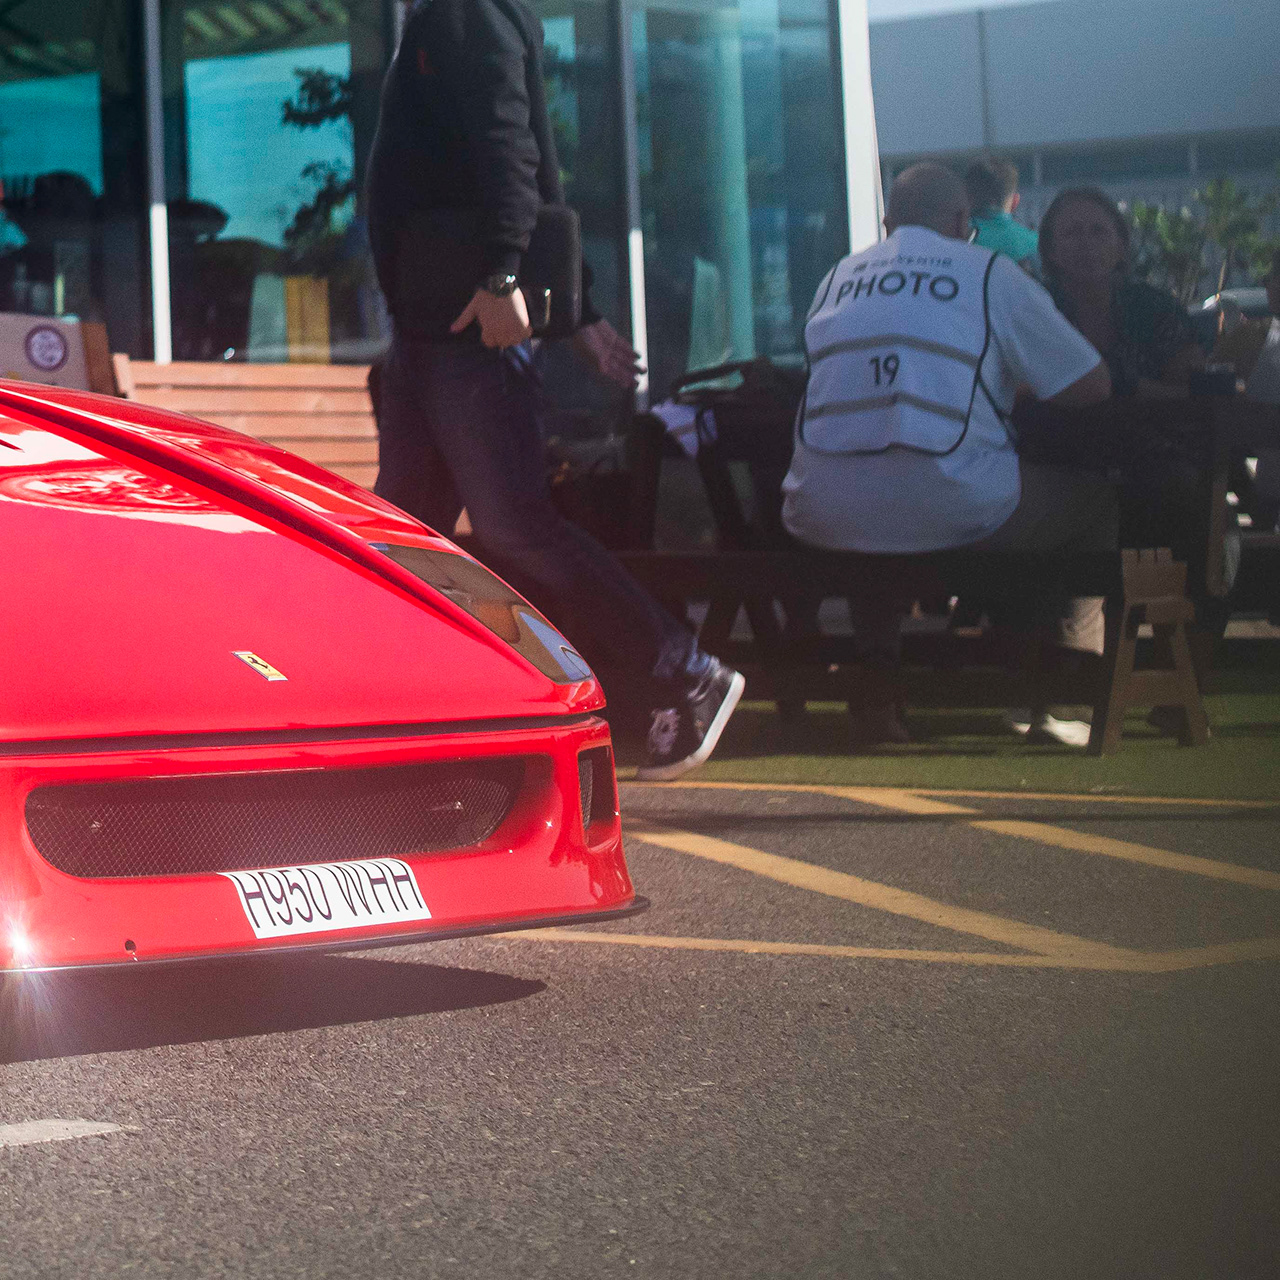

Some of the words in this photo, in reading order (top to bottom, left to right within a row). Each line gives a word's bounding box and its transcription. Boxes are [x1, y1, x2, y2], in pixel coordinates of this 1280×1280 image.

[835, 271, 960, 306] PHOTO
[869, 352, 901, 387] 19
[229, 867, 333, 929] H950
[319, 858, 424, 917] WHH
